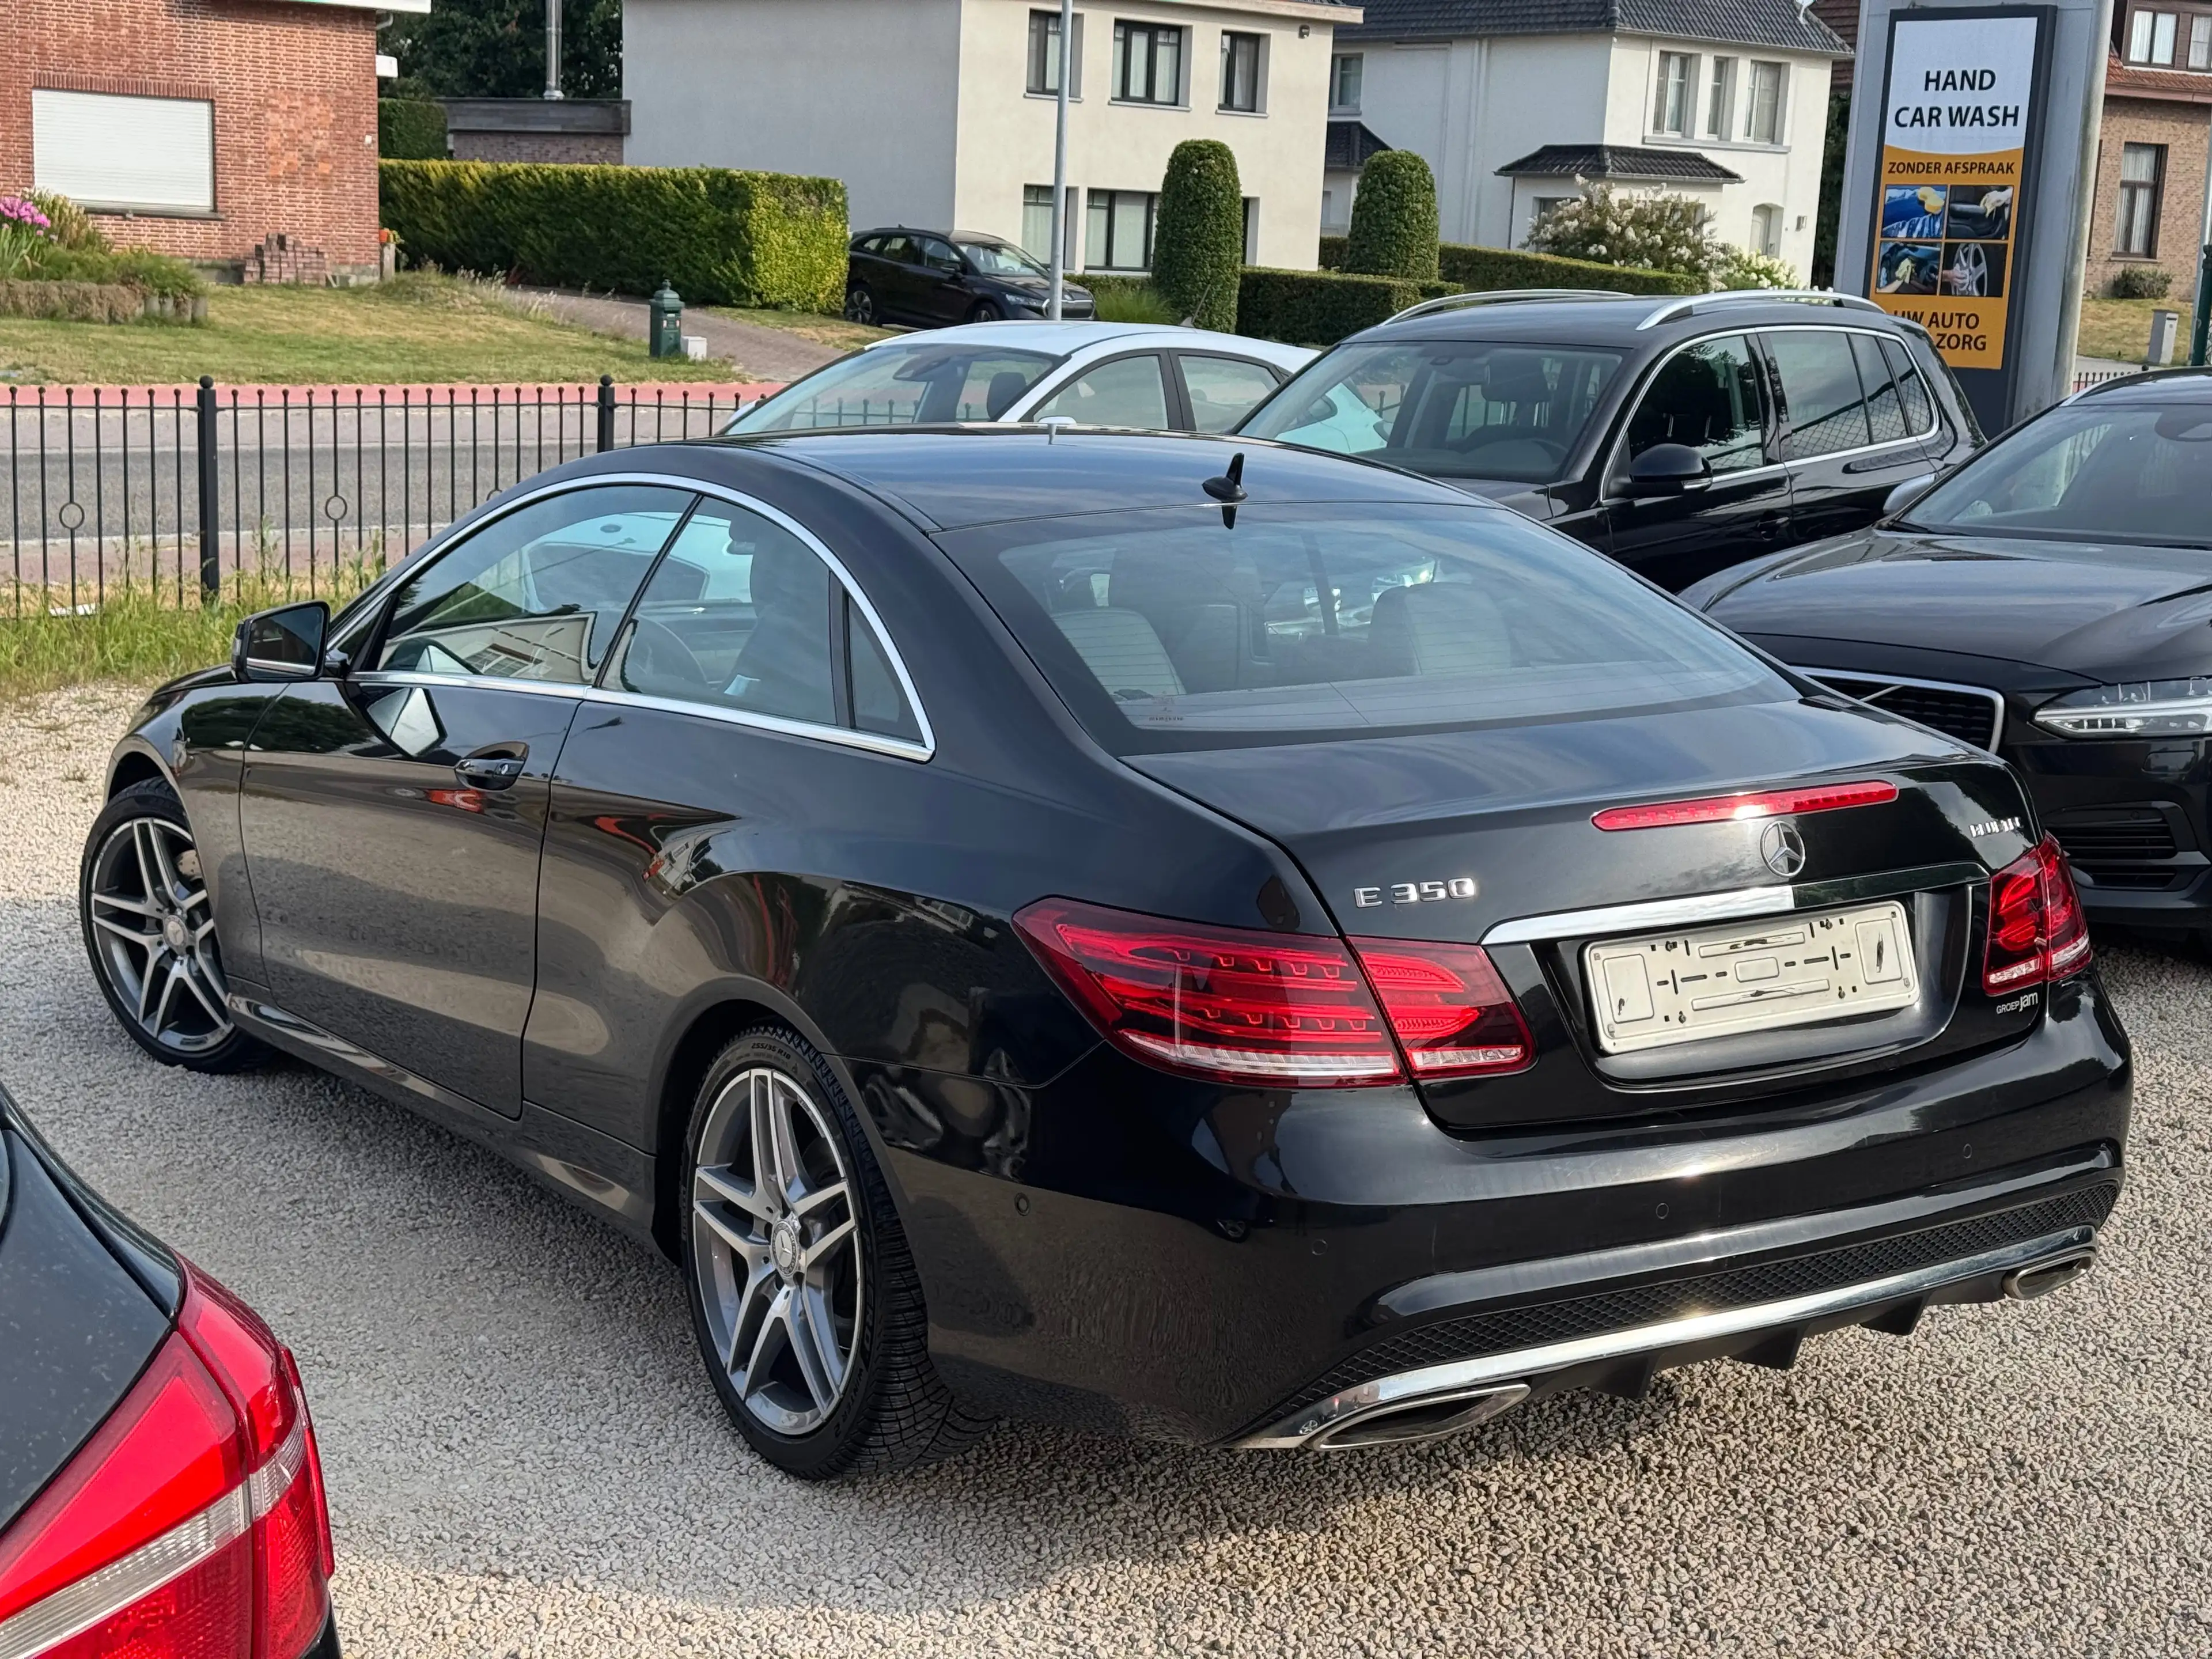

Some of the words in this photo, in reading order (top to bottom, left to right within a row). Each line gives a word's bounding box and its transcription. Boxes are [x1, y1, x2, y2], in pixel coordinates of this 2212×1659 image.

[1924, 69, 1997, 92] HAND
[1895, 105, 1942, 128] CAR
[1948, 105, 2020, 127] WASH
[1888, 162, 1942, 175] ZONDER
[1944, 161, 2015, 175] AFSPRAAK
[1927, 312, 1980, 329] AUTO
[1936, 333, 1987, 351] ZORG
[1354, 887, 1382, 908] E
[1390, 877, 1475, 904] 350
[1996, 1001, 2020, 1014] GROEP
